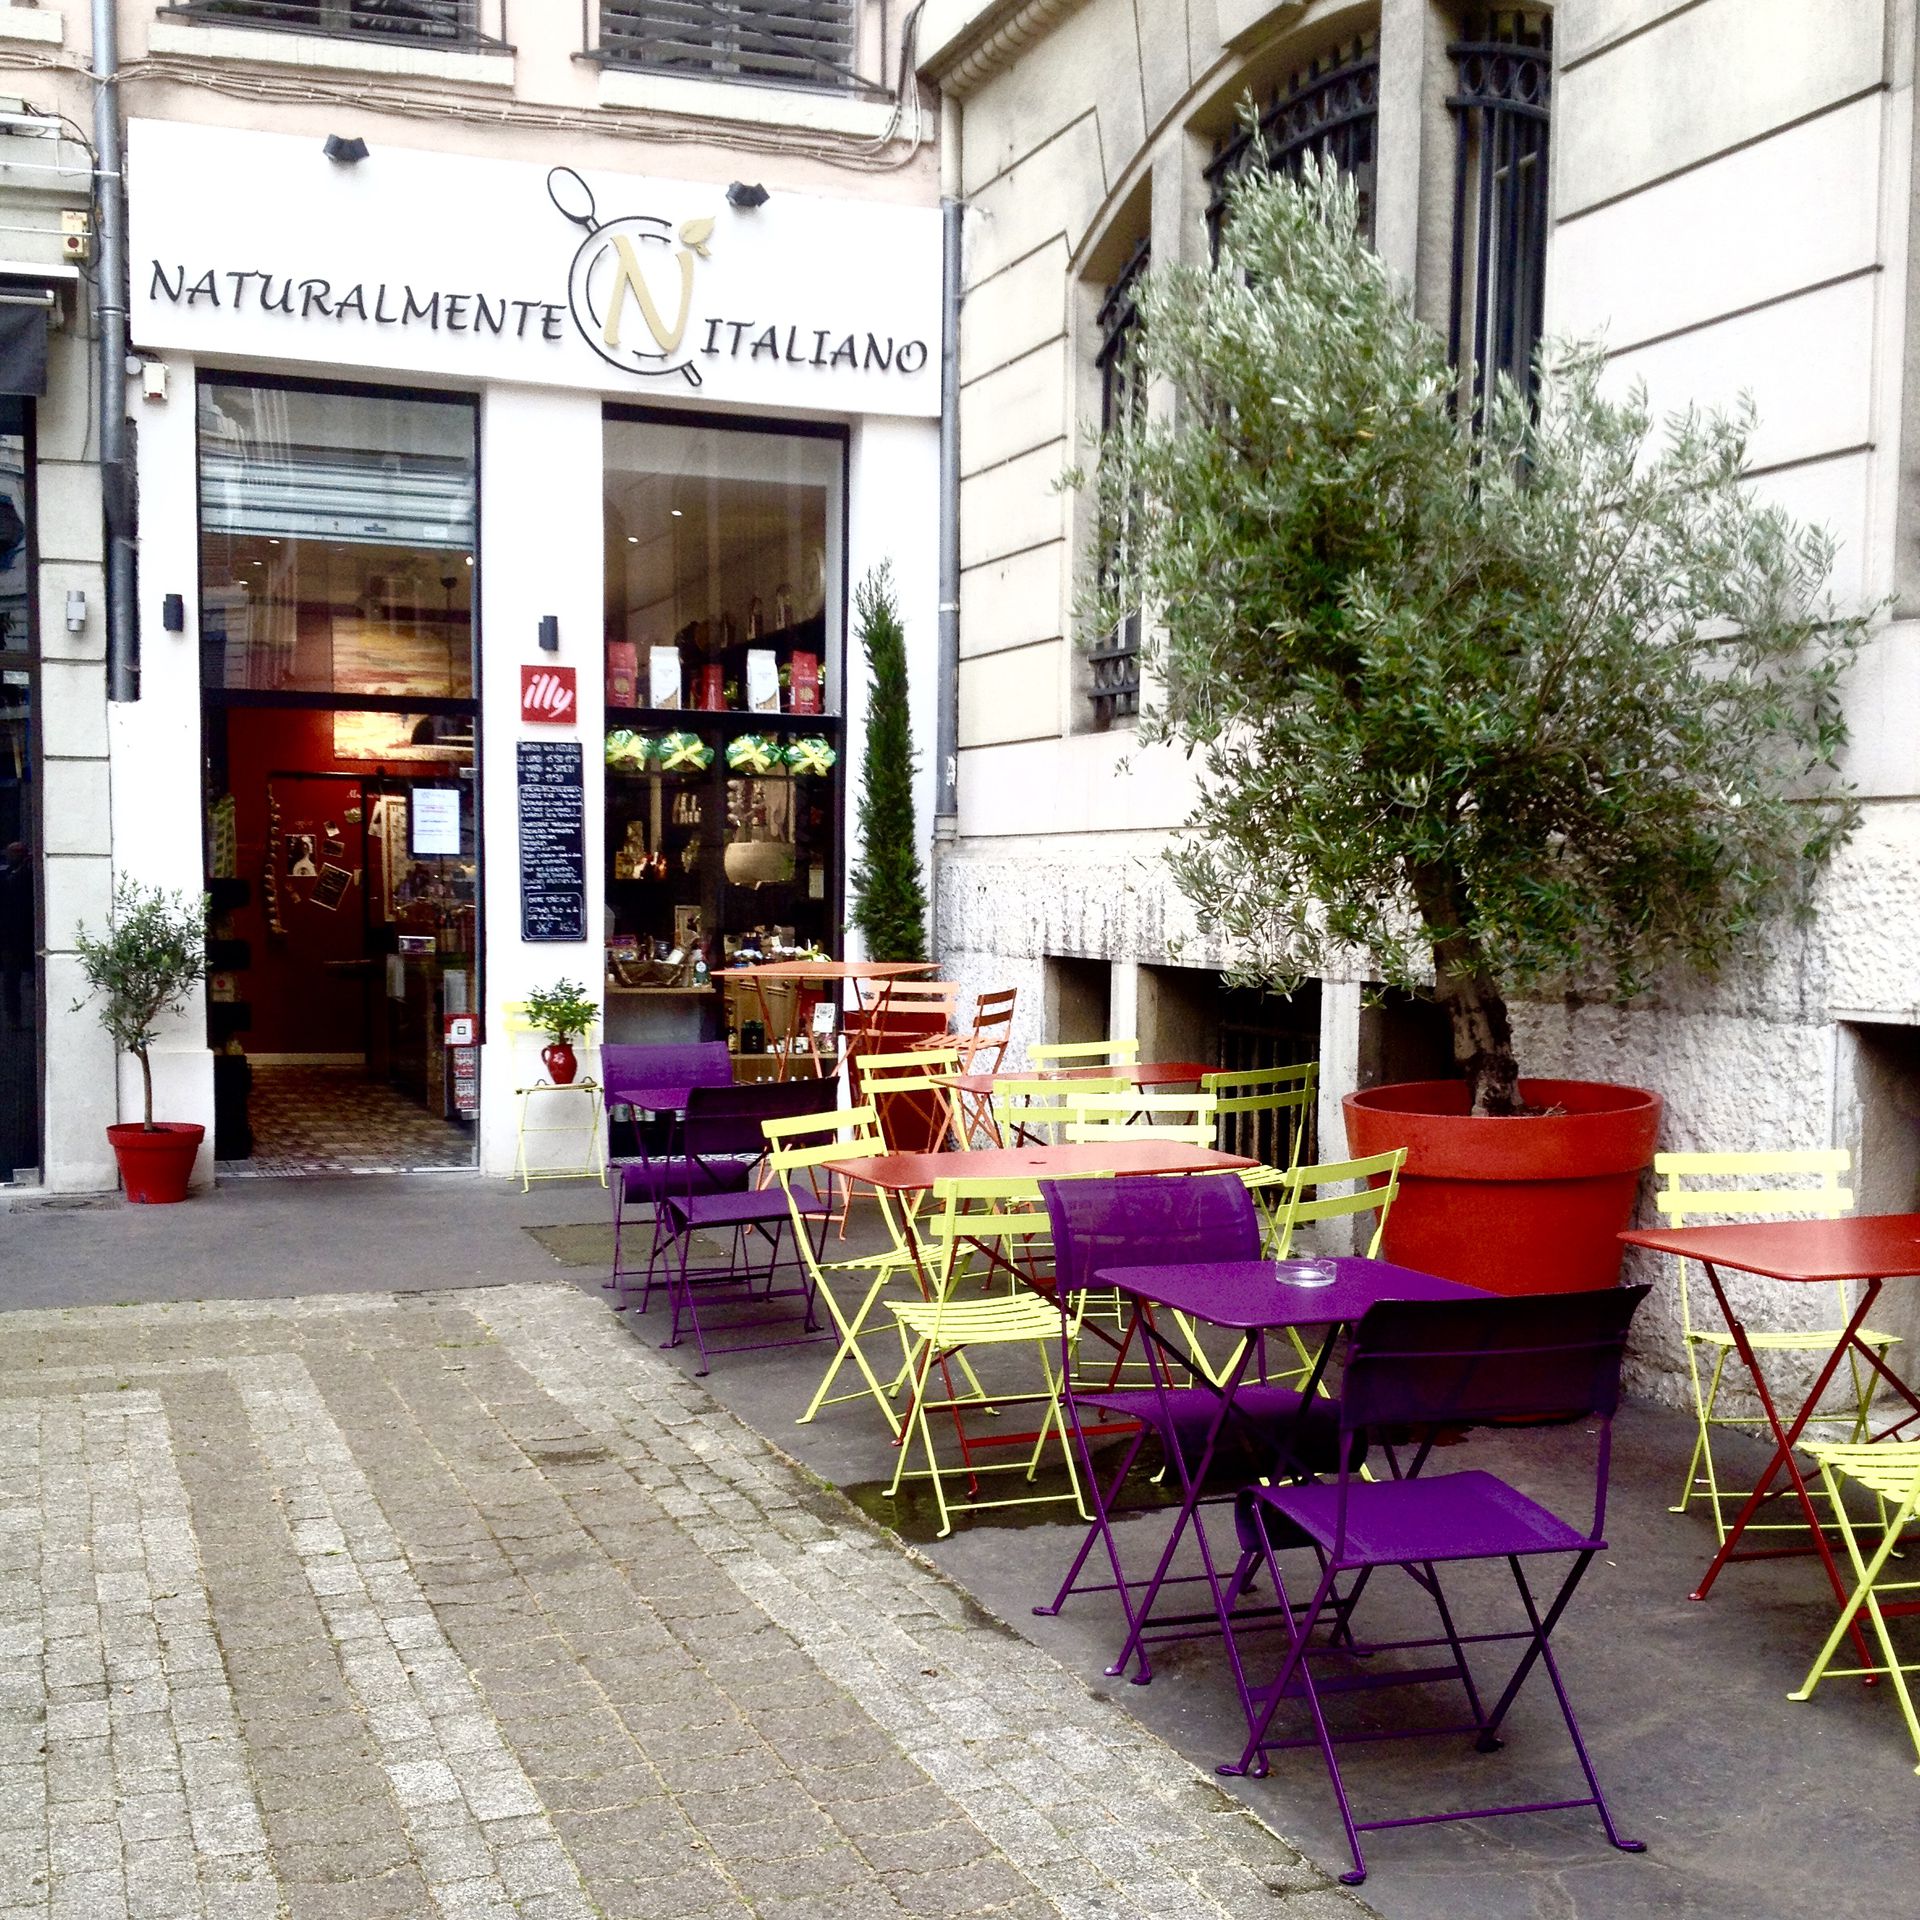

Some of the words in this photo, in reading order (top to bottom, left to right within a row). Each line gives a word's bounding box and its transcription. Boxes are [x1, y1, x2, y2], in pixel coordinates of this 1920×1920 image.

[149, 259, 568, 340] NATURALMENTE
[604, 234, 695, 354] N
[700, 317, 929, 374] ITALIANO
[523, 672, 574, 718] illy
